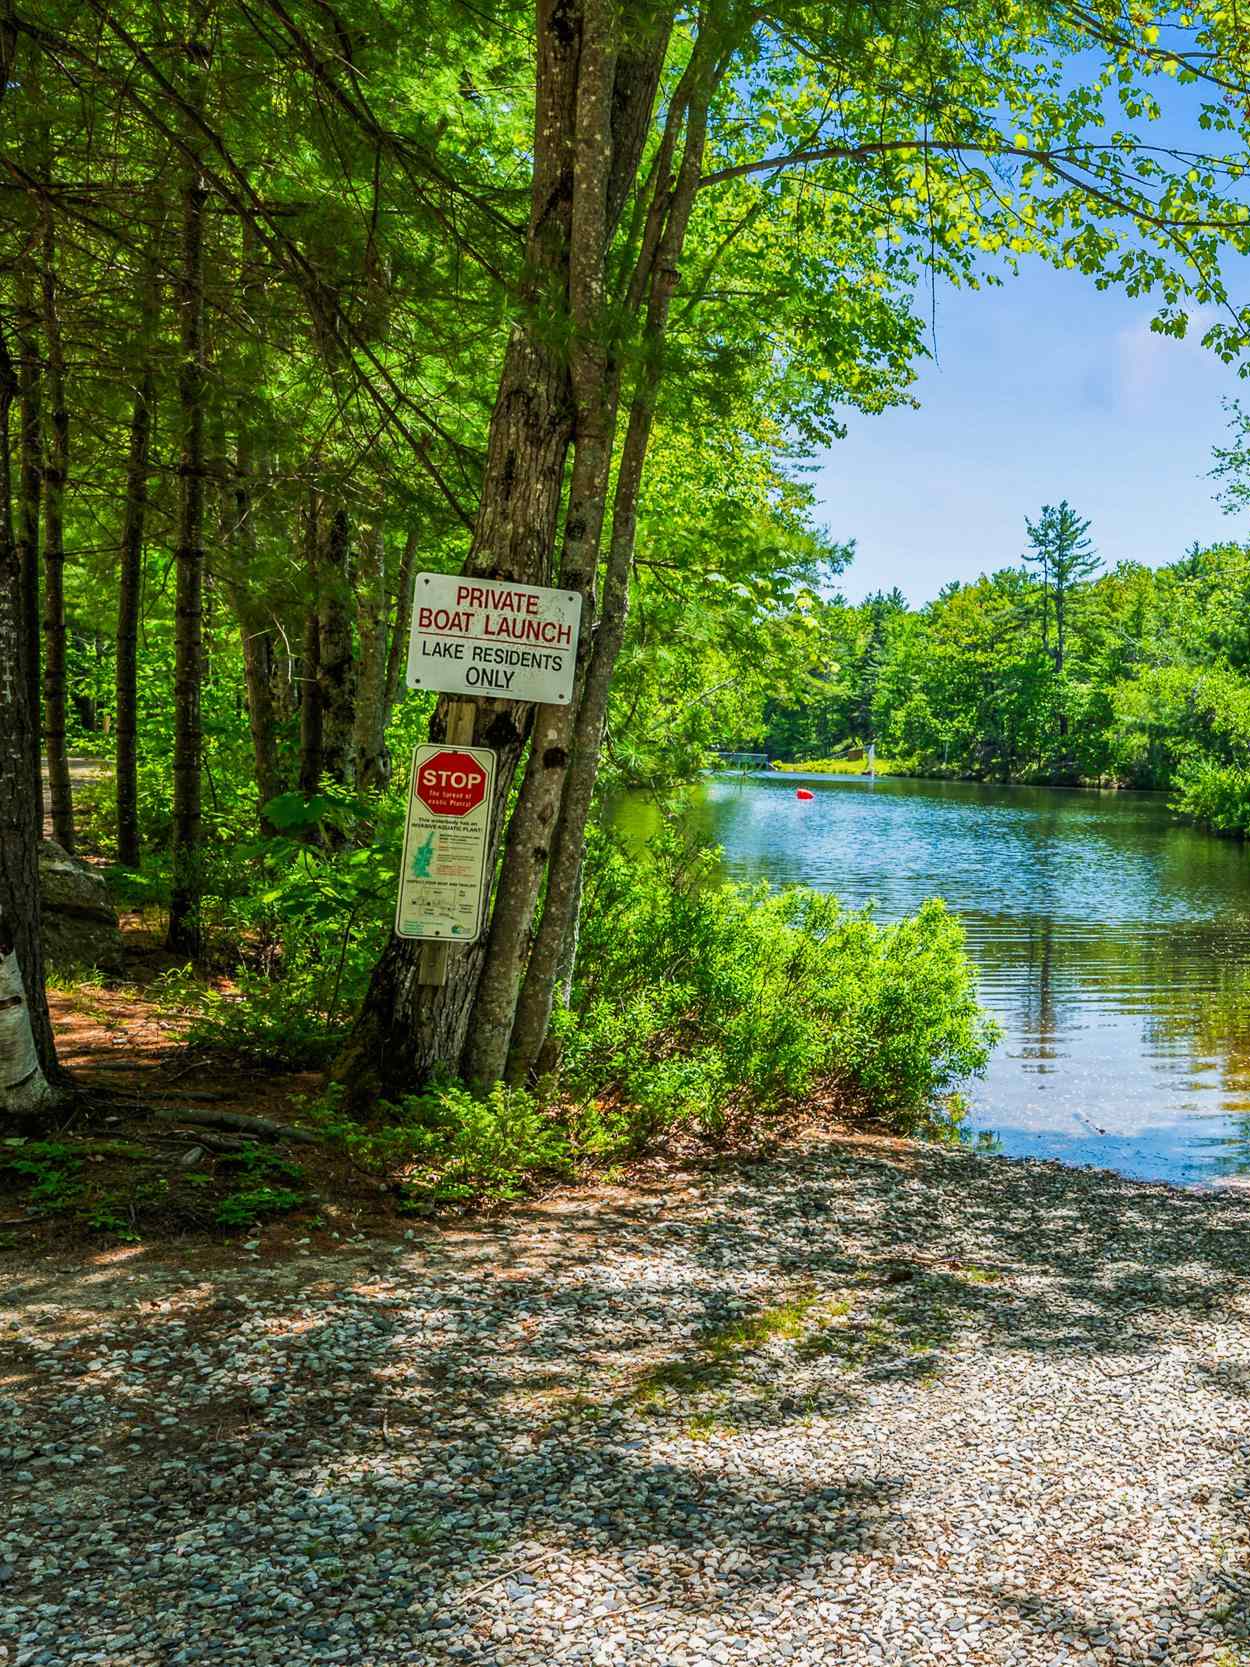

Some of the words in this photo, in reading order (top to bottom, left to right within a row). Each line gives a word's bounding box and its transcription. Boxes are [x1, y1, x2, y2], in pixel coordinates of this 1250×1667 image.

[456, 586, 540, 615] PRIVATE
[418, 607, 475, 633] BOAT
[484, 615, 572, 645] LAUNCH
[422, 640, 465, 660] LAKE
[472, 646, 562, 672] RESIDENTS
[465, 666, 515, 689] ONLY
[423, 769, 482, 790] STOP
